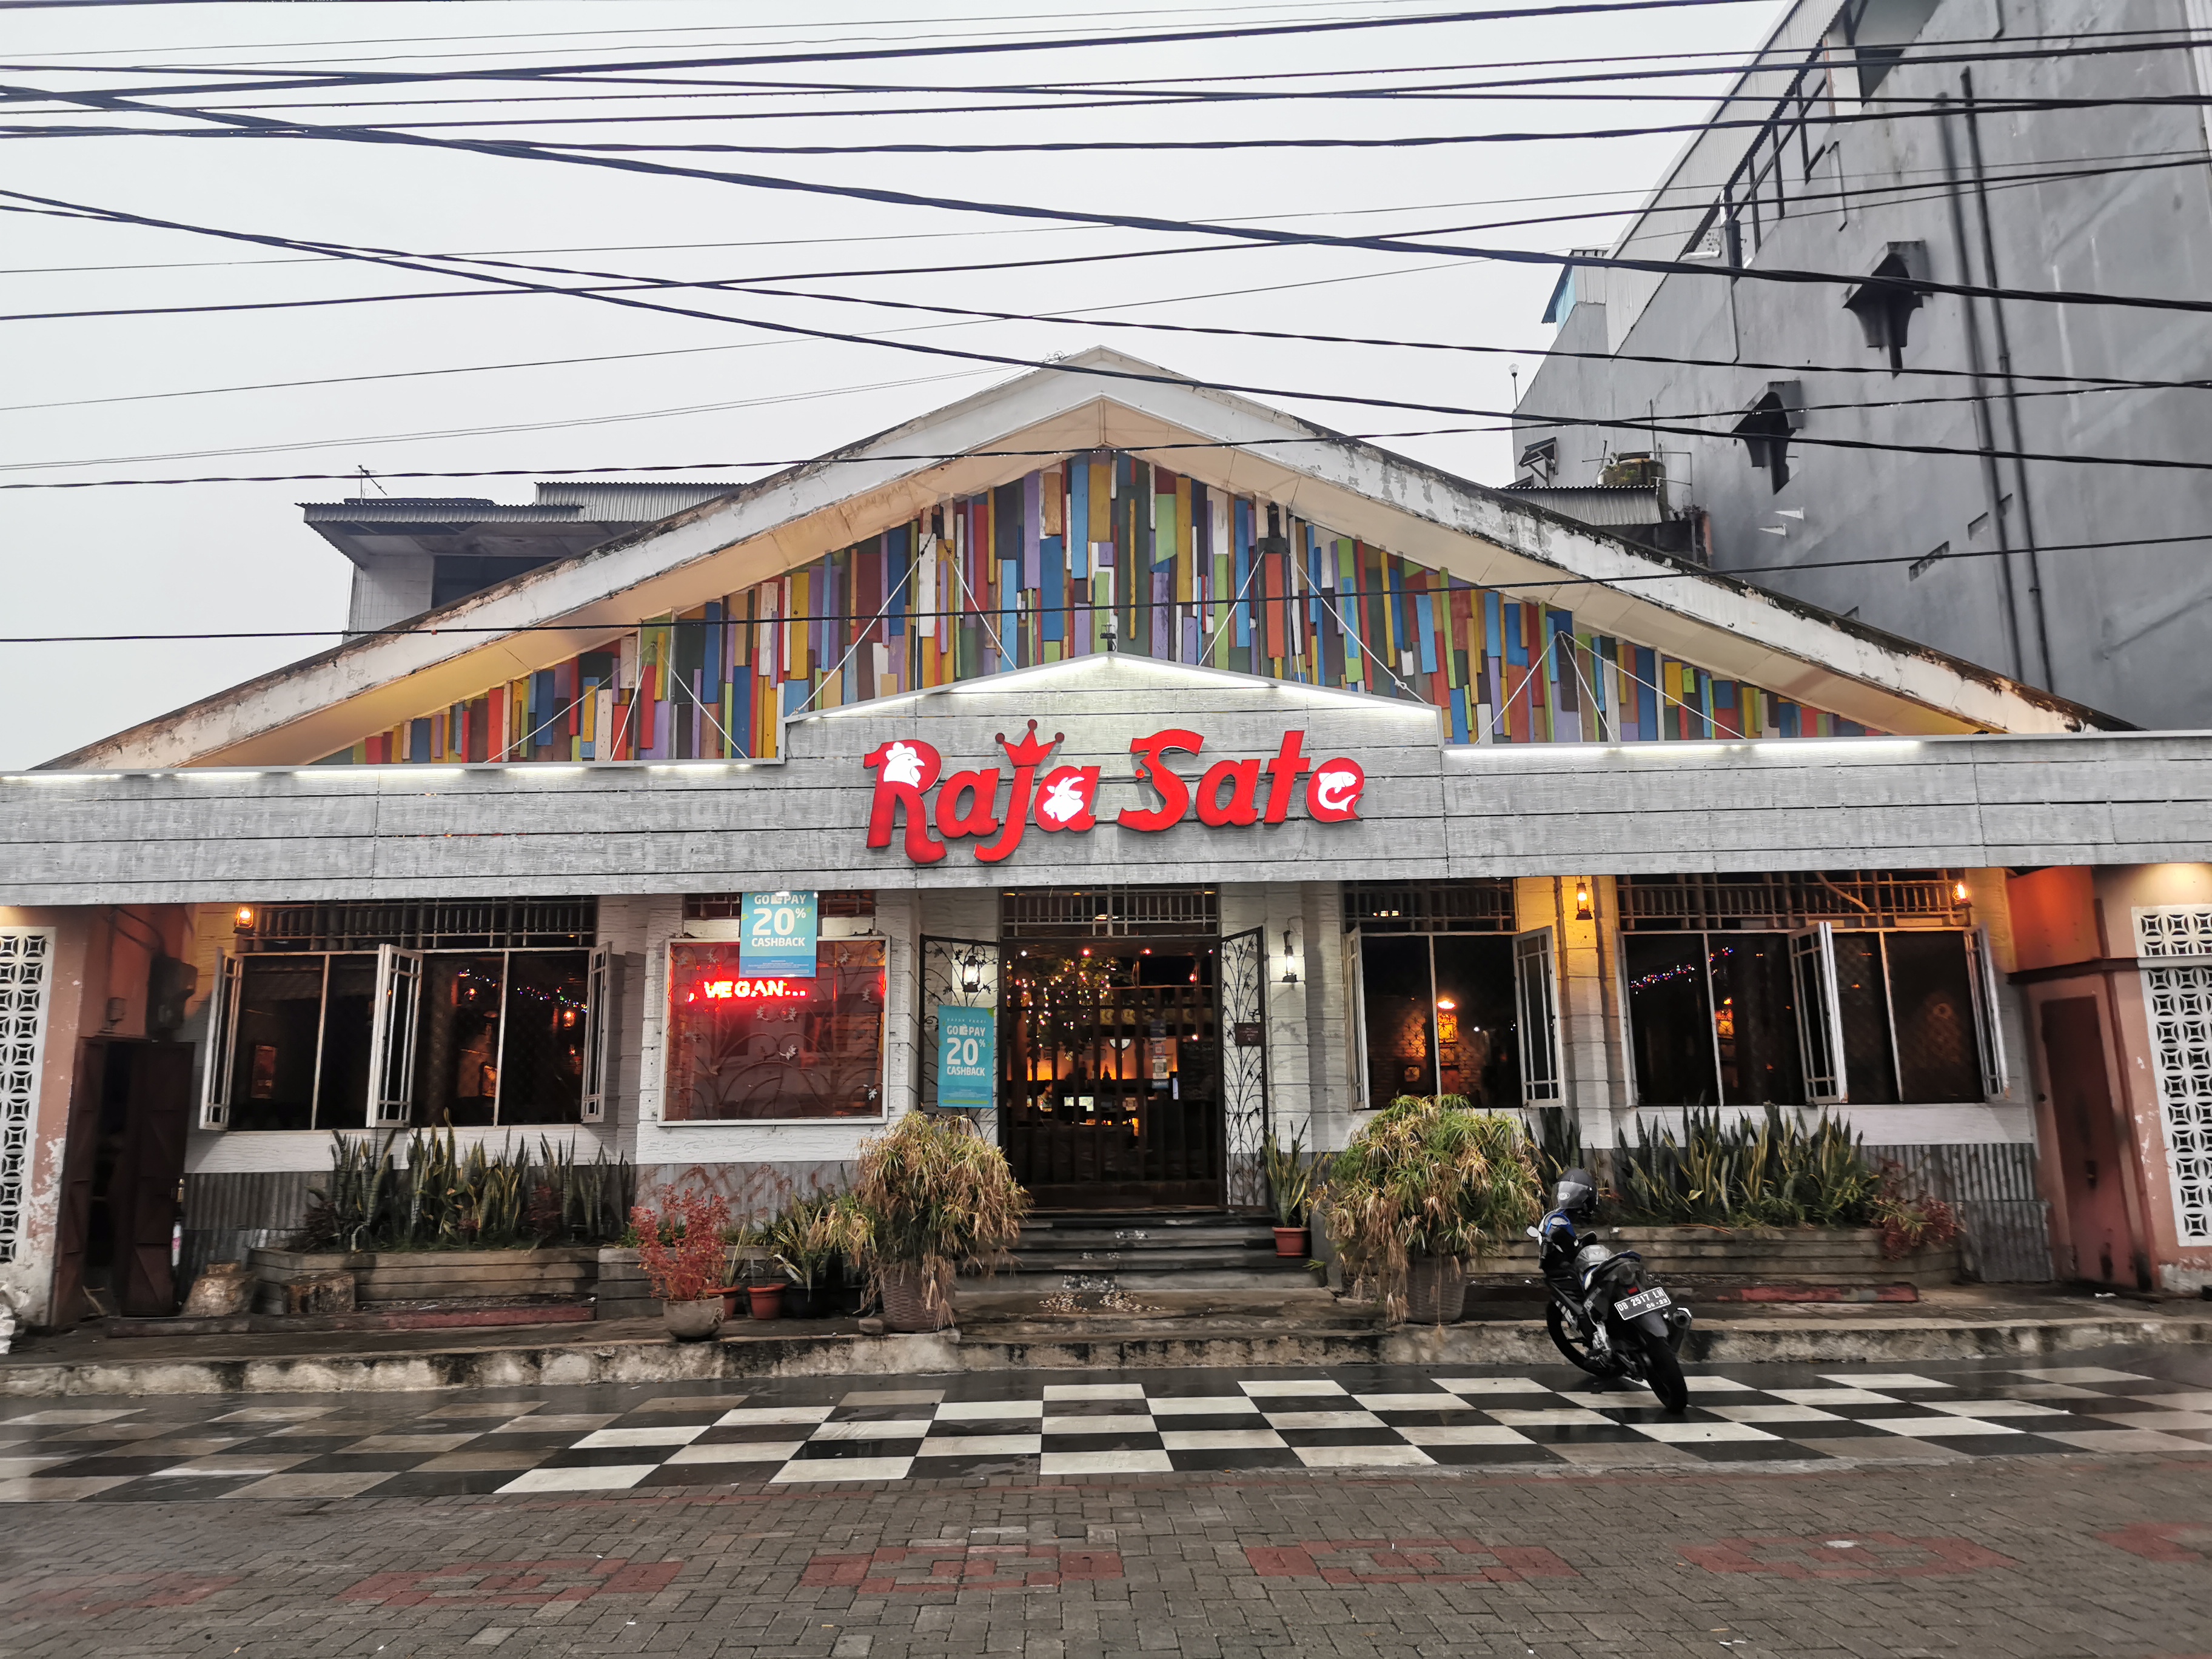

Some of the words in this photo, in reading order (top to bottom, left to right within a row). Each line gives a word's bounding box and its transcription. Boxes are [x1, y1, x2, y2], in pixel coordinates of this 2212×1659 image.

[863, 739, 1101, 864] Raja
[1117, 729, 1366, 832] Sate
[751, 937, 805, 947] CASHBACK
[947, 1066, 985, 1076] CASHBACK
[1617, 1302, 1629, 1312] DB
[1630, 1293, 1650, 1306] 2517
